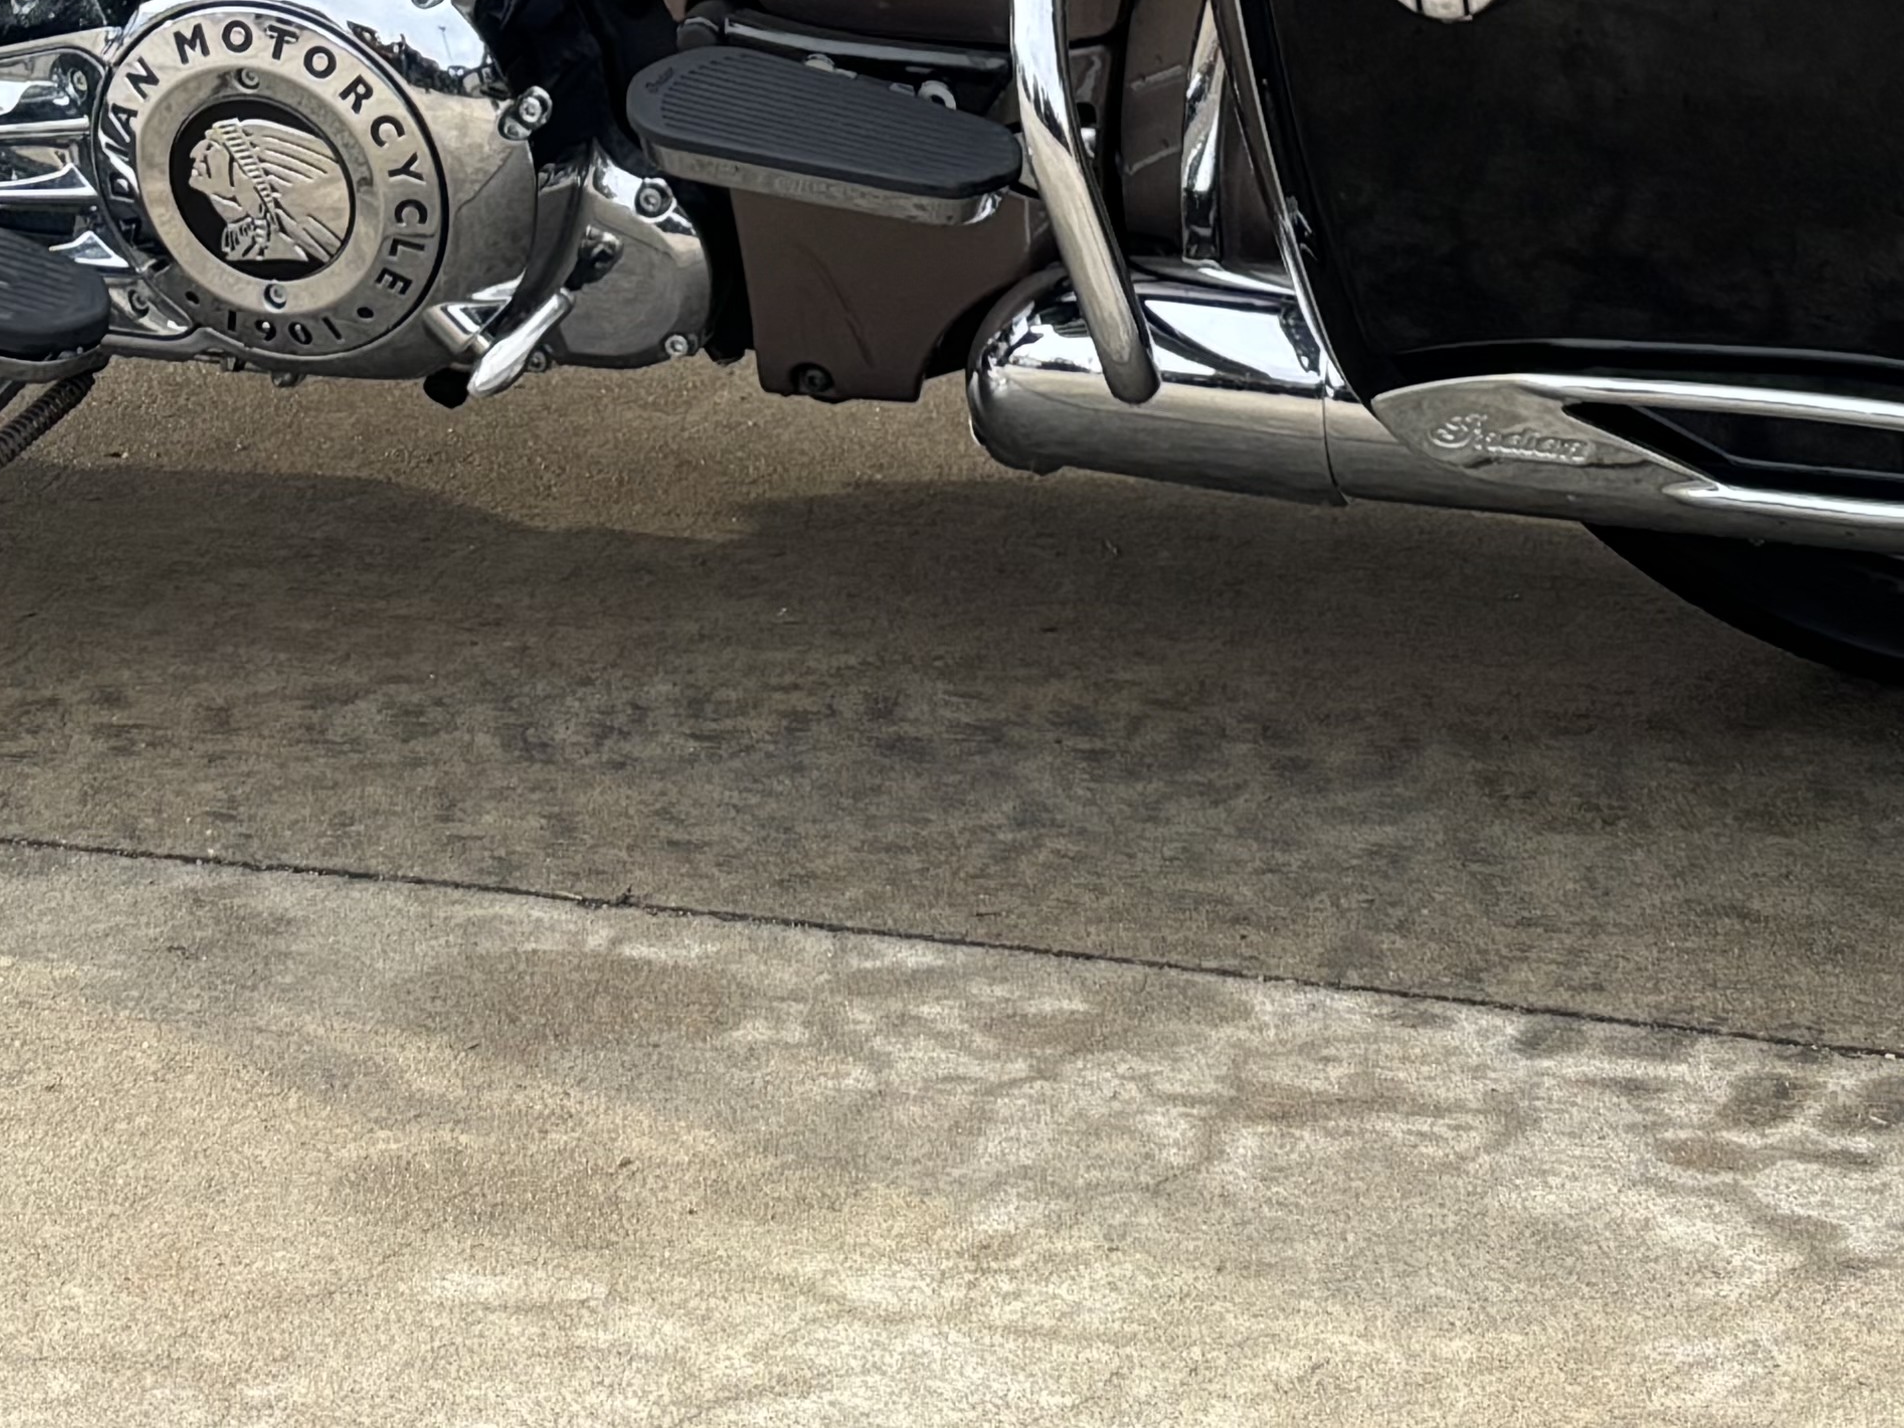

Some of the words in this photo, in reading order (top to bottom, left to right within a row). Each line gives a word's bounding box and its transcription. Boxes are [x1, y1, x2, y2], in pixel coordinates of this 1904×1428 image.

[172, 19, 429, 296] MOTORCYCLE
[227, 310, 343, 346] 1901
[1426, 413, 1586, 463] Indian
